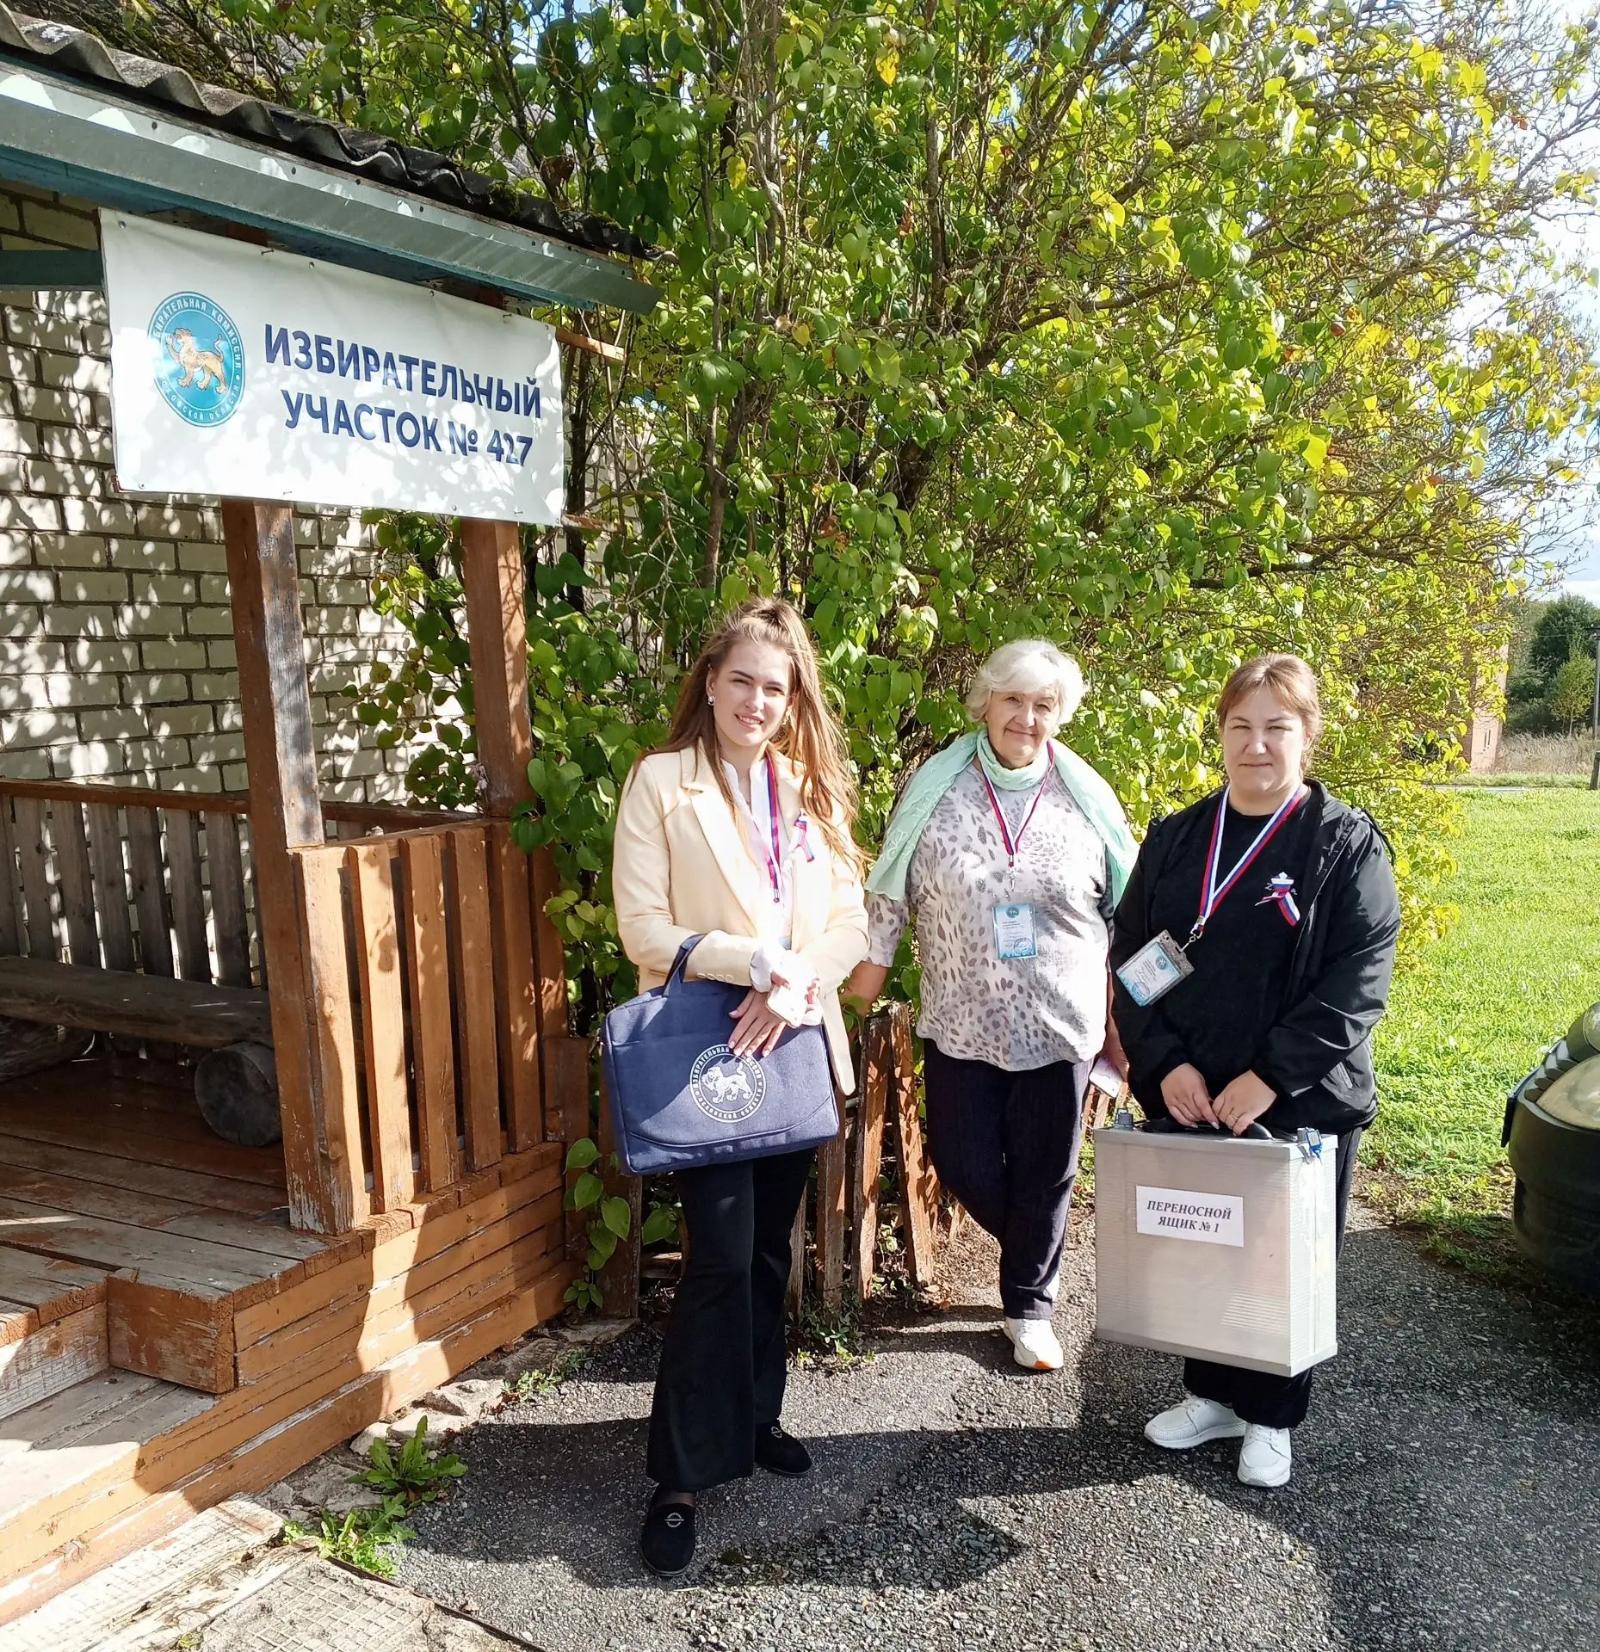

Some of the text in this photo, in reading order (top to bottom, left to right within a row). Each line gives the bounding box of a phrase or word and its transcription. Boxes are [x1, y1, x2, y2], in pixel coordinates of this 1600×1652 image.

[211, 308, 242, 369] КОМИССИЯ
[265, 324, 541, 418] ИЗБИРАТЕЛЬНЫЙ
[281, 389, 533, 467] УЧАСТОК № 427
[1146, 1200, 1232, 1220] ПЕРЕНОСНОЙ
[1157, 1215, 1220, 1234] ЯЩИК № 1
